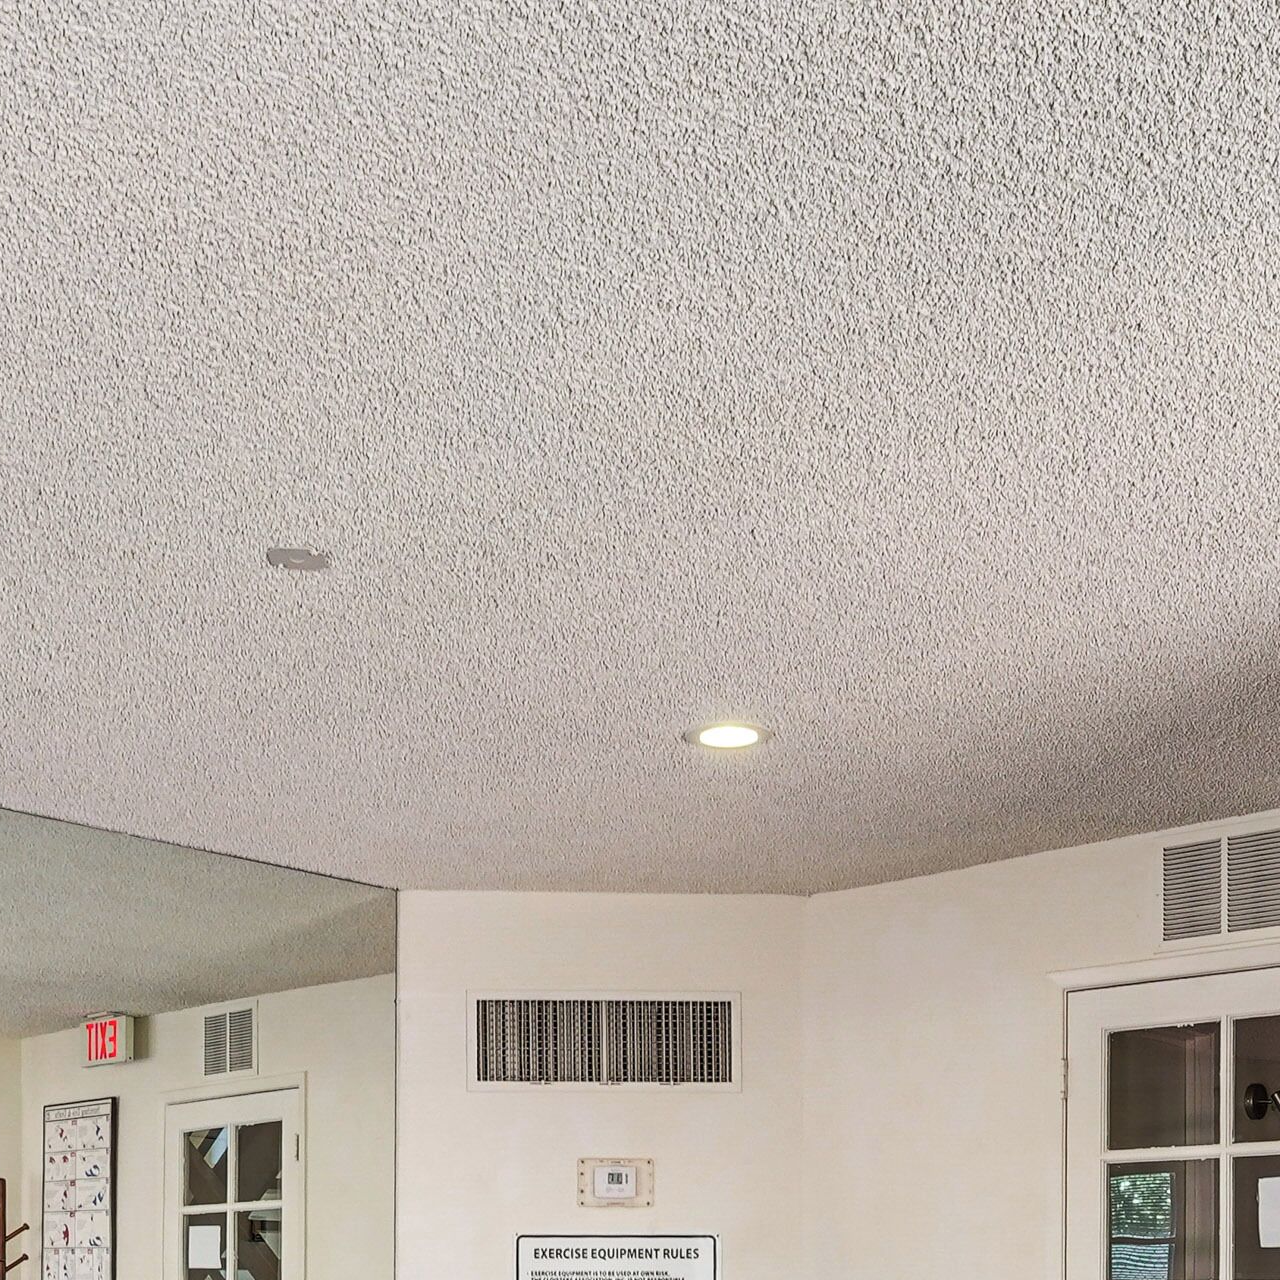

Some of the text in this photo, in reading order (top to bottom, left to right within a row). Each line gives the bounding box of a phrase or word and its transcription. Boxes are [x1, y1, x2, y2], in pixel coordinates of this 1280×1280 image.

[533, 1248, 700, 1260] EXERCISE EQUIPMENT RULES
